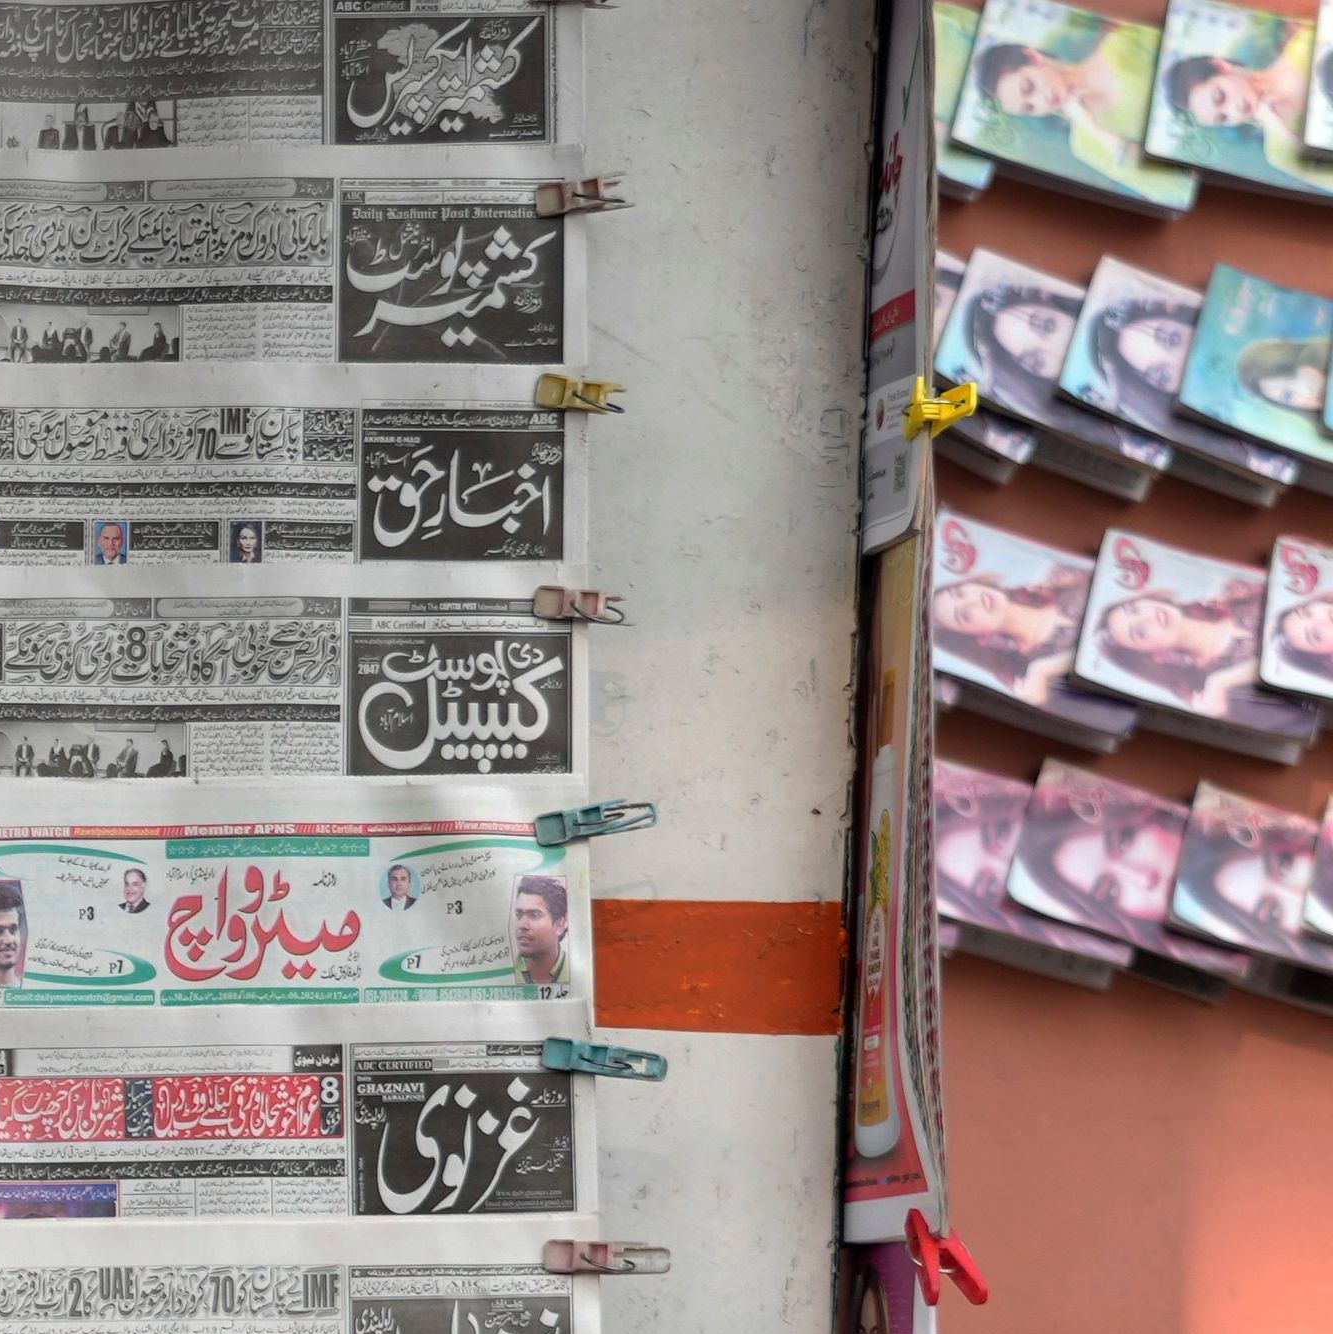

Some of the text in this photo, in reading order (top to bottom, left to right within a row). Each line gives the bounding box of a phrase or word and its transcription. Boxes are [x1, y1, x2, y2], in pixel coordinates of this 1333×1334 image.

[335, 1, 362, 12] ABC
[441, 208, 470, 220] Post
[472, 207, 538, 219] Internatio
[31, 827, 71, 838] WATCH
[185, 823, 296, 838] Member APNS
[356, 1060, 431, 1071] ABC CERTIFIED
[357, 1082, 424, 1094] GHAZNAVI
